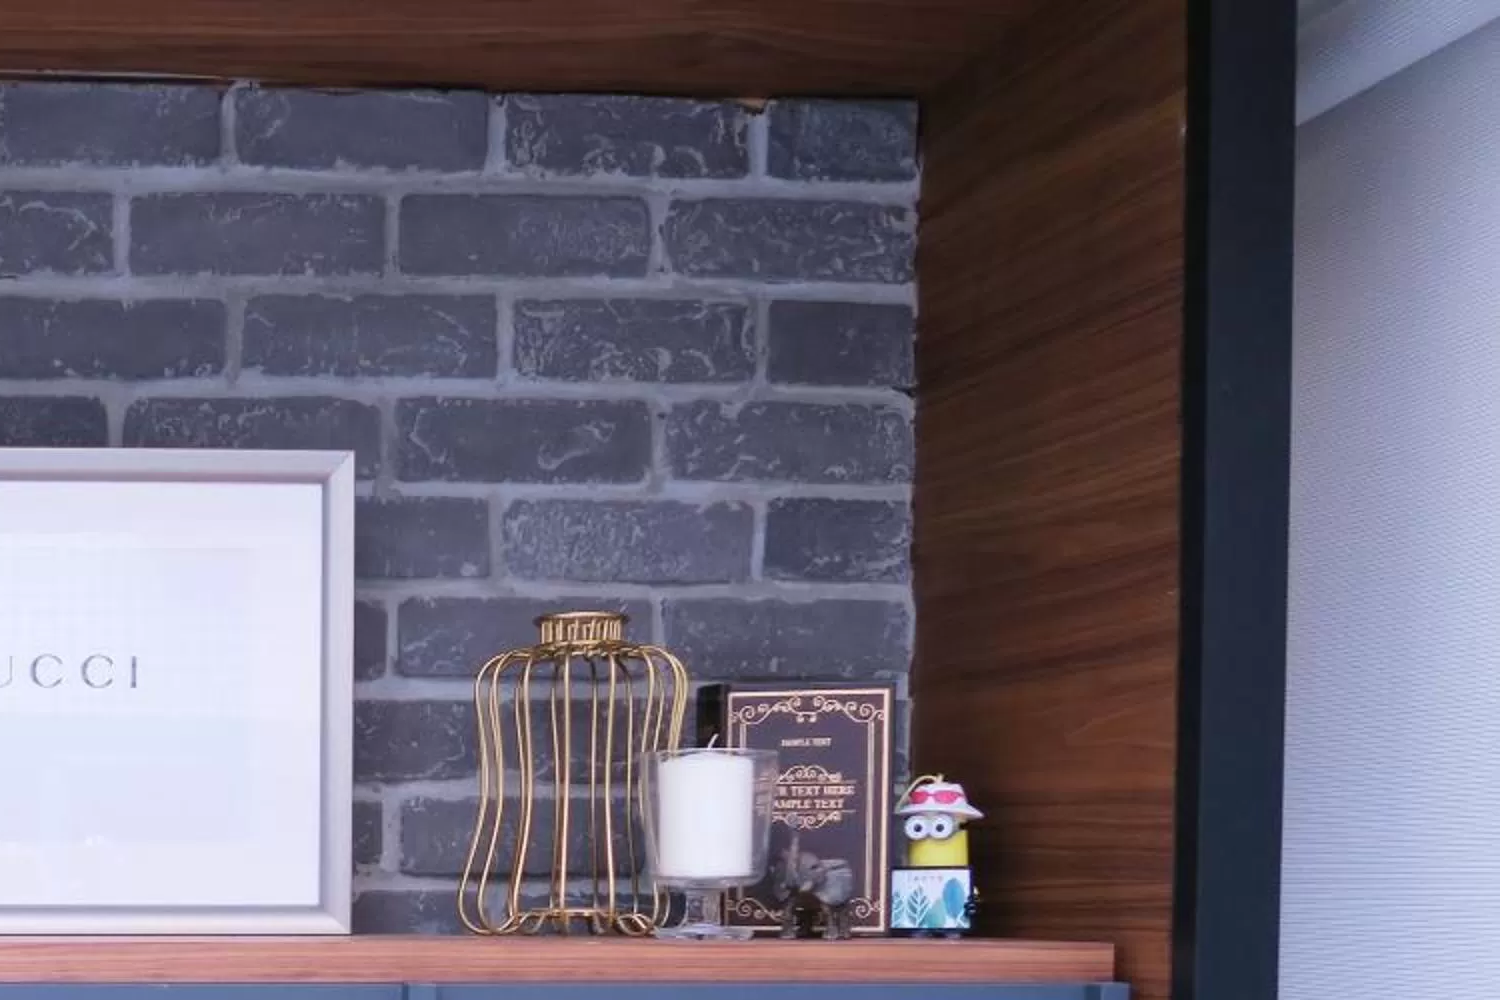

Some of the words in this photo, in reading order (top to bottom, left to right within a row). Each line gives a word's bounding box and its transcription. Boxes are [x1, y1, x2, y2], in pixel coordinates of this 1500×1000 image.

[791, 785, 820, 797] TEXT
[773, 799, 812, 809] AMPLE
[814, 798, 845, 809] TEXT
